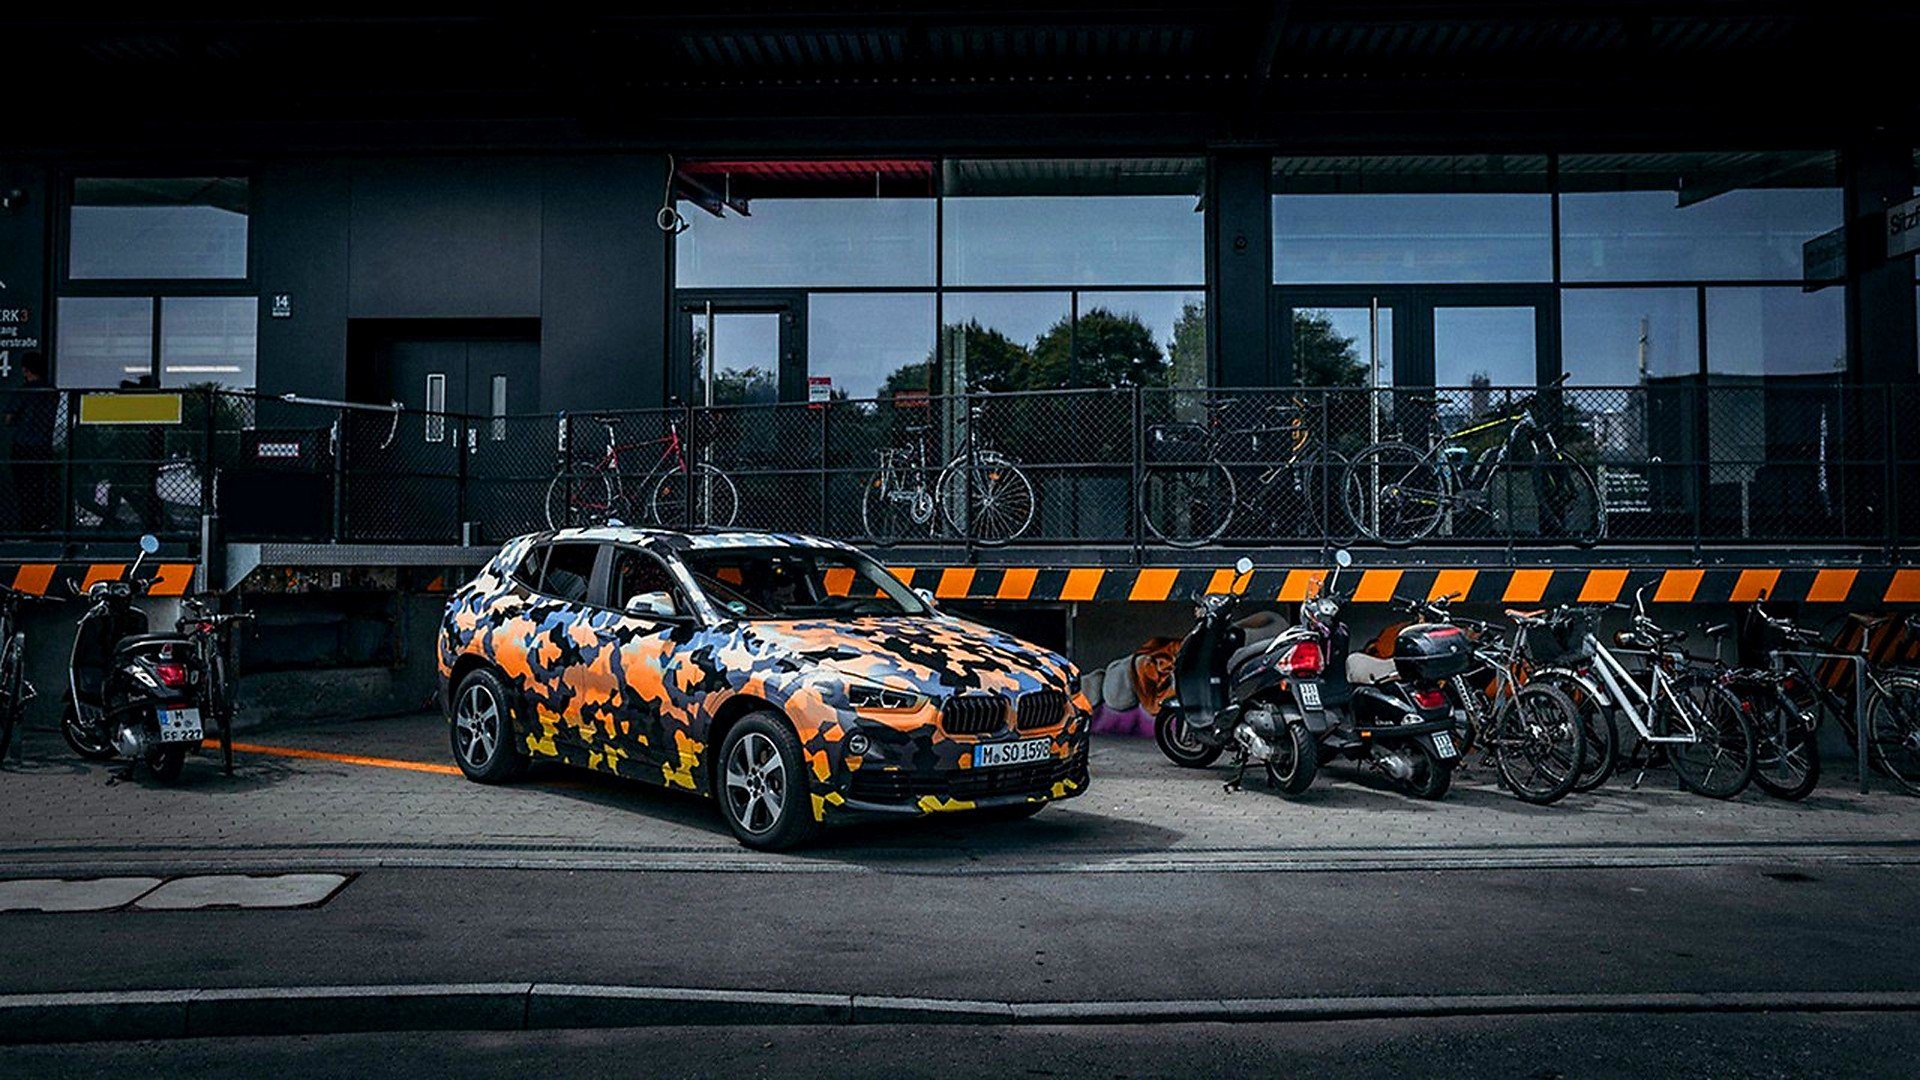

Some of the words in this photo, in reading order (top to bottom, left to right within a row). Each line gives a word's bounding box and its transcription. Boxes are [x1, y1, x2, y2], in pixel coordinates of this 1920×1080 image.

[276, 295, 288, 307] 14
[983, 747, 993, 764] M
[1002, 744, 1019, 762] SO
